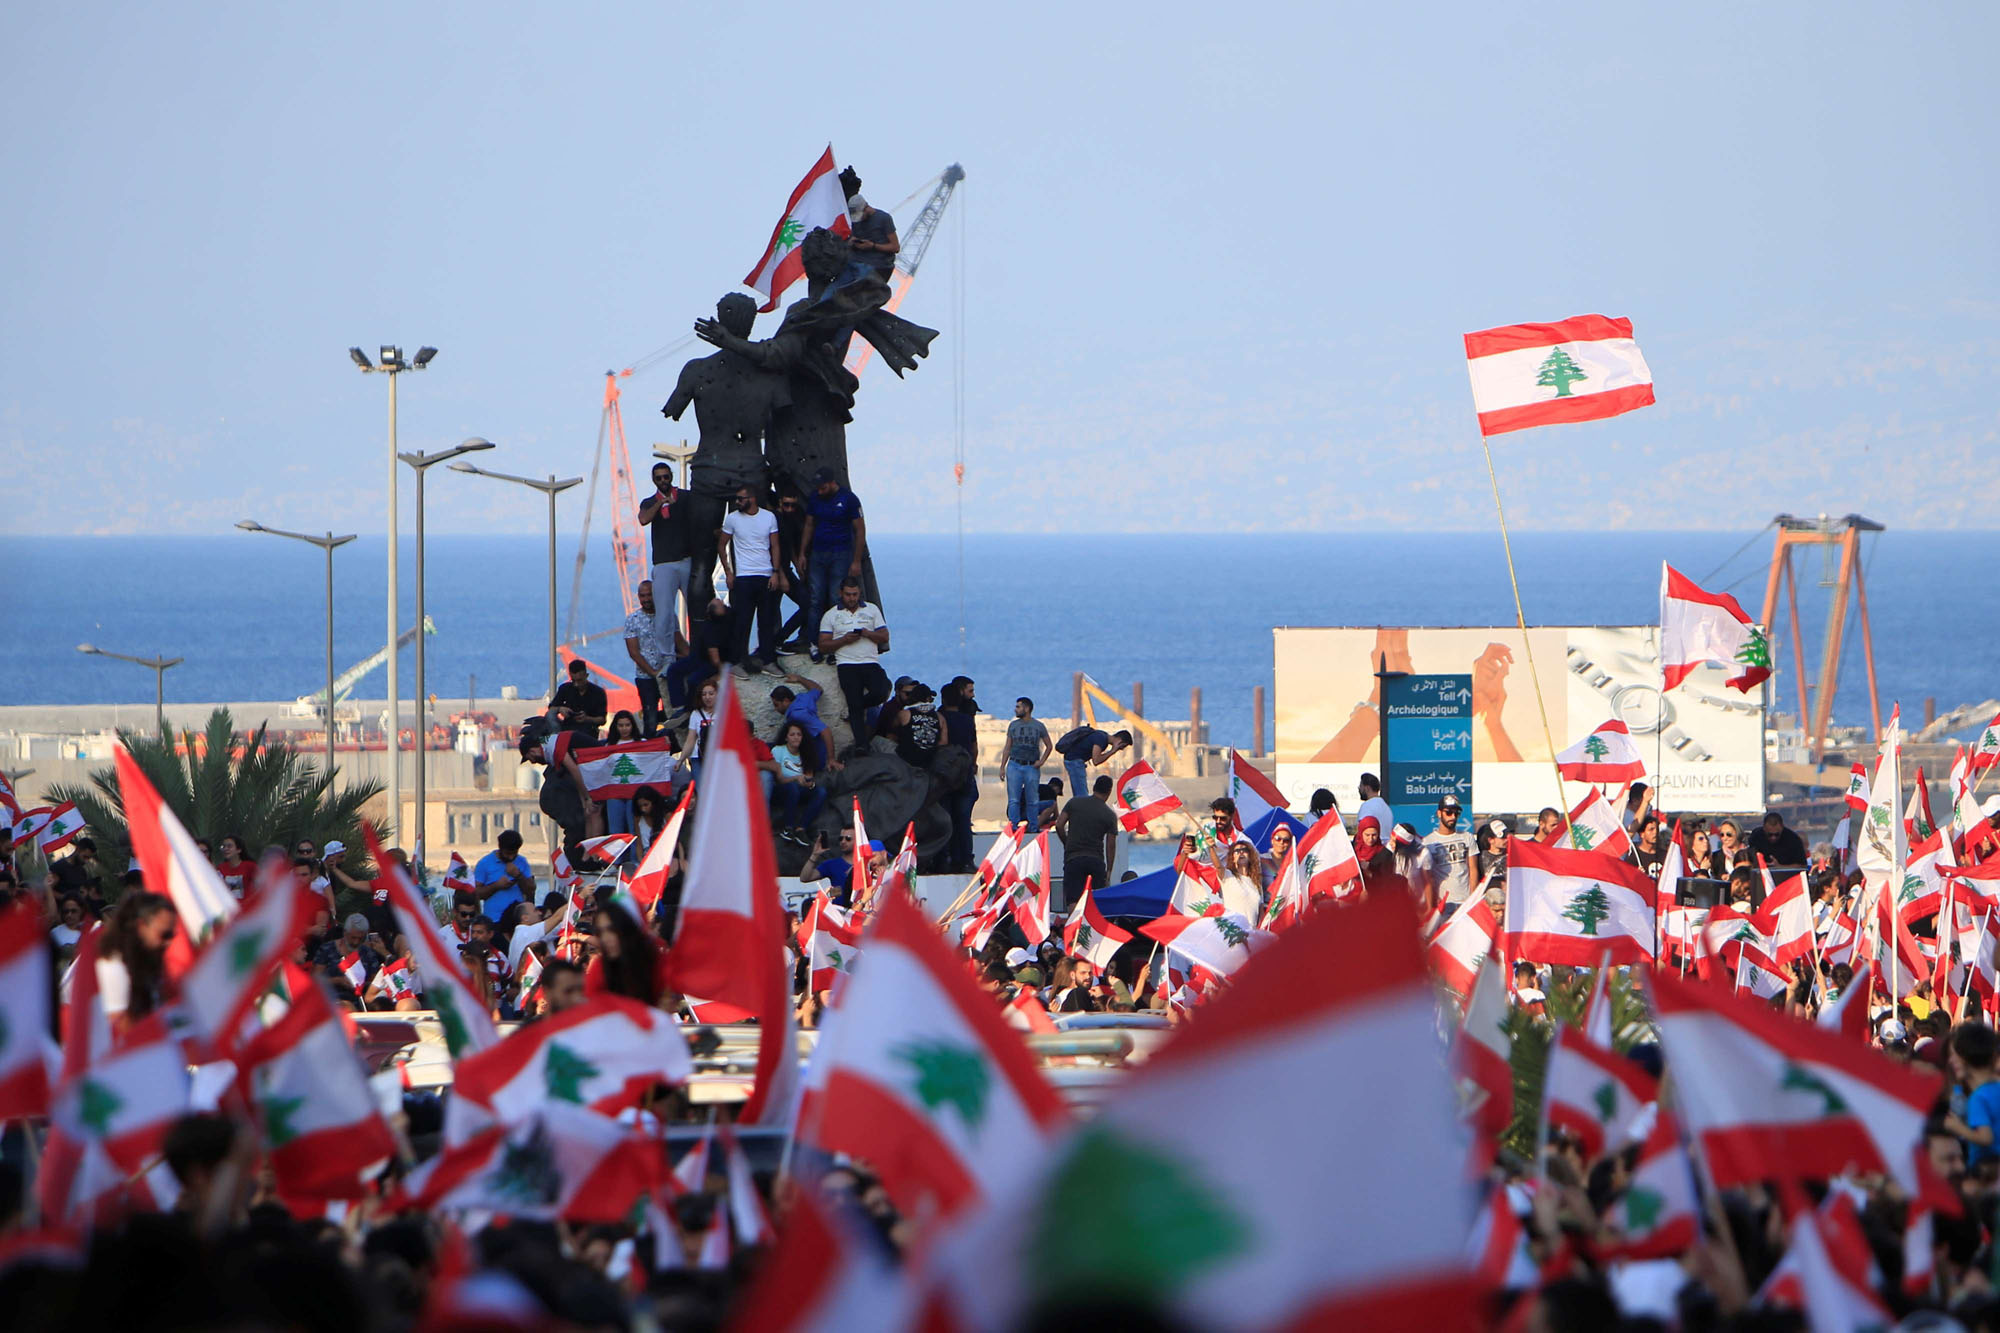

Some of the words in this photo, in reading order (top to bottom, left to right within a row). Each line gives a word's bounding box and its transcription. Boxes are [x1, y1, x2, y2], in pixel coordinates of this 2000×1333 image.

[1438, 691, 1456, 701] Tell
[1387, 704, 1459, 716] Archéologique
[1434, 740, 1456, 750] Port
[1439, 771, 1456, 782] باب
[1649, 774, 1704, 788] CALVIN
[1708, 774, 1749, 788] KLEIN
[1406, 784, 1426, 794] Bab
[1428, 784, 1455, 794] Idriss
